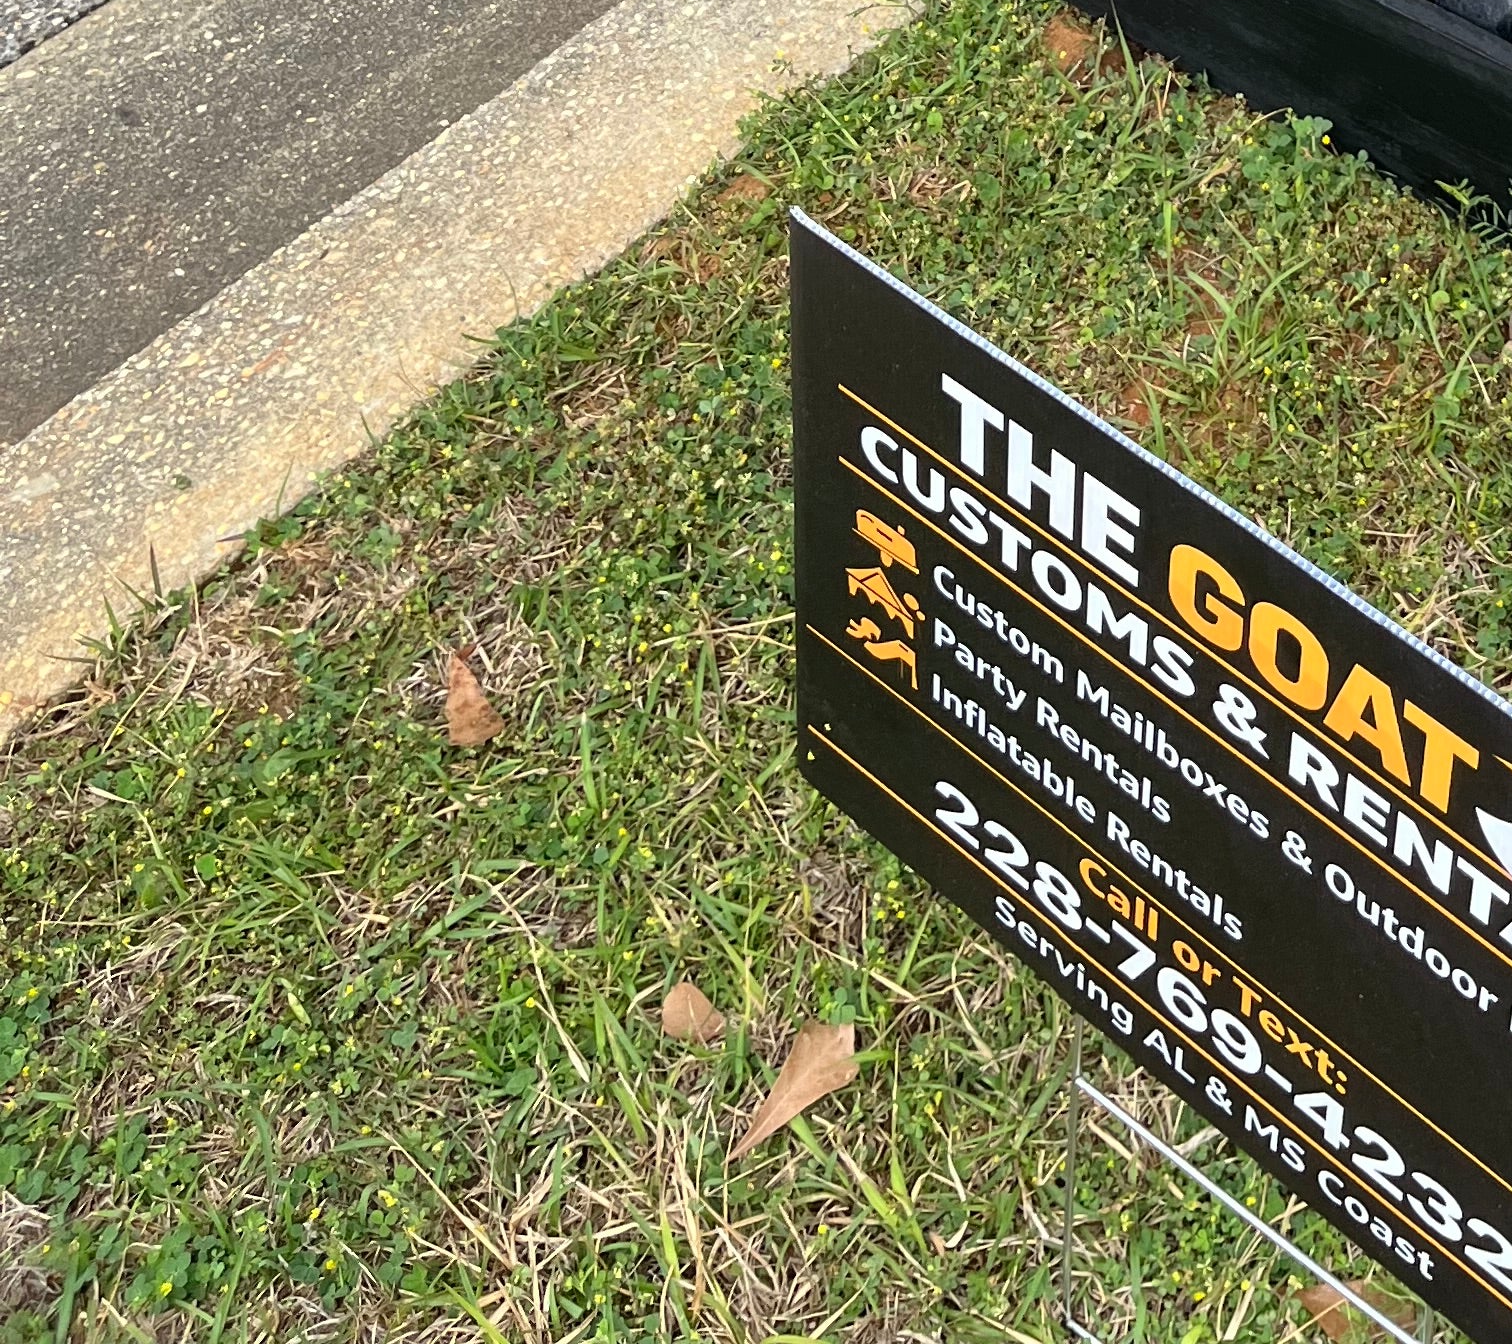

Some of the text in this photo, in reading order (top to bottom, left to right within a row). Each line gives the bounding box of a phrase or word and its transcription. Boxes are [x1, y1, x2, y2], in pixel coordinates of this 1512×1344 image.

[860, 426, 1196, 697] CUSTOMS
[1212, 683, 1270, 759] &
[933, 618, 1172, 823] Party Rentals
[942, 372, 1479, 813] THE GOAT
[931, 673, 1243, 941] Inflatable Rentals
[933, 565, 1065, 684] Custom
[1076, 670, 1270, 839] Mailboxes
[1281, 830, 1313, 875] &
[1324, 863, 1499, 1011] Outdoor
[995, 896, 1437, 1282] Serving AL & MS Coast
[1079, 858, 1348, 1094] Call or Text:
